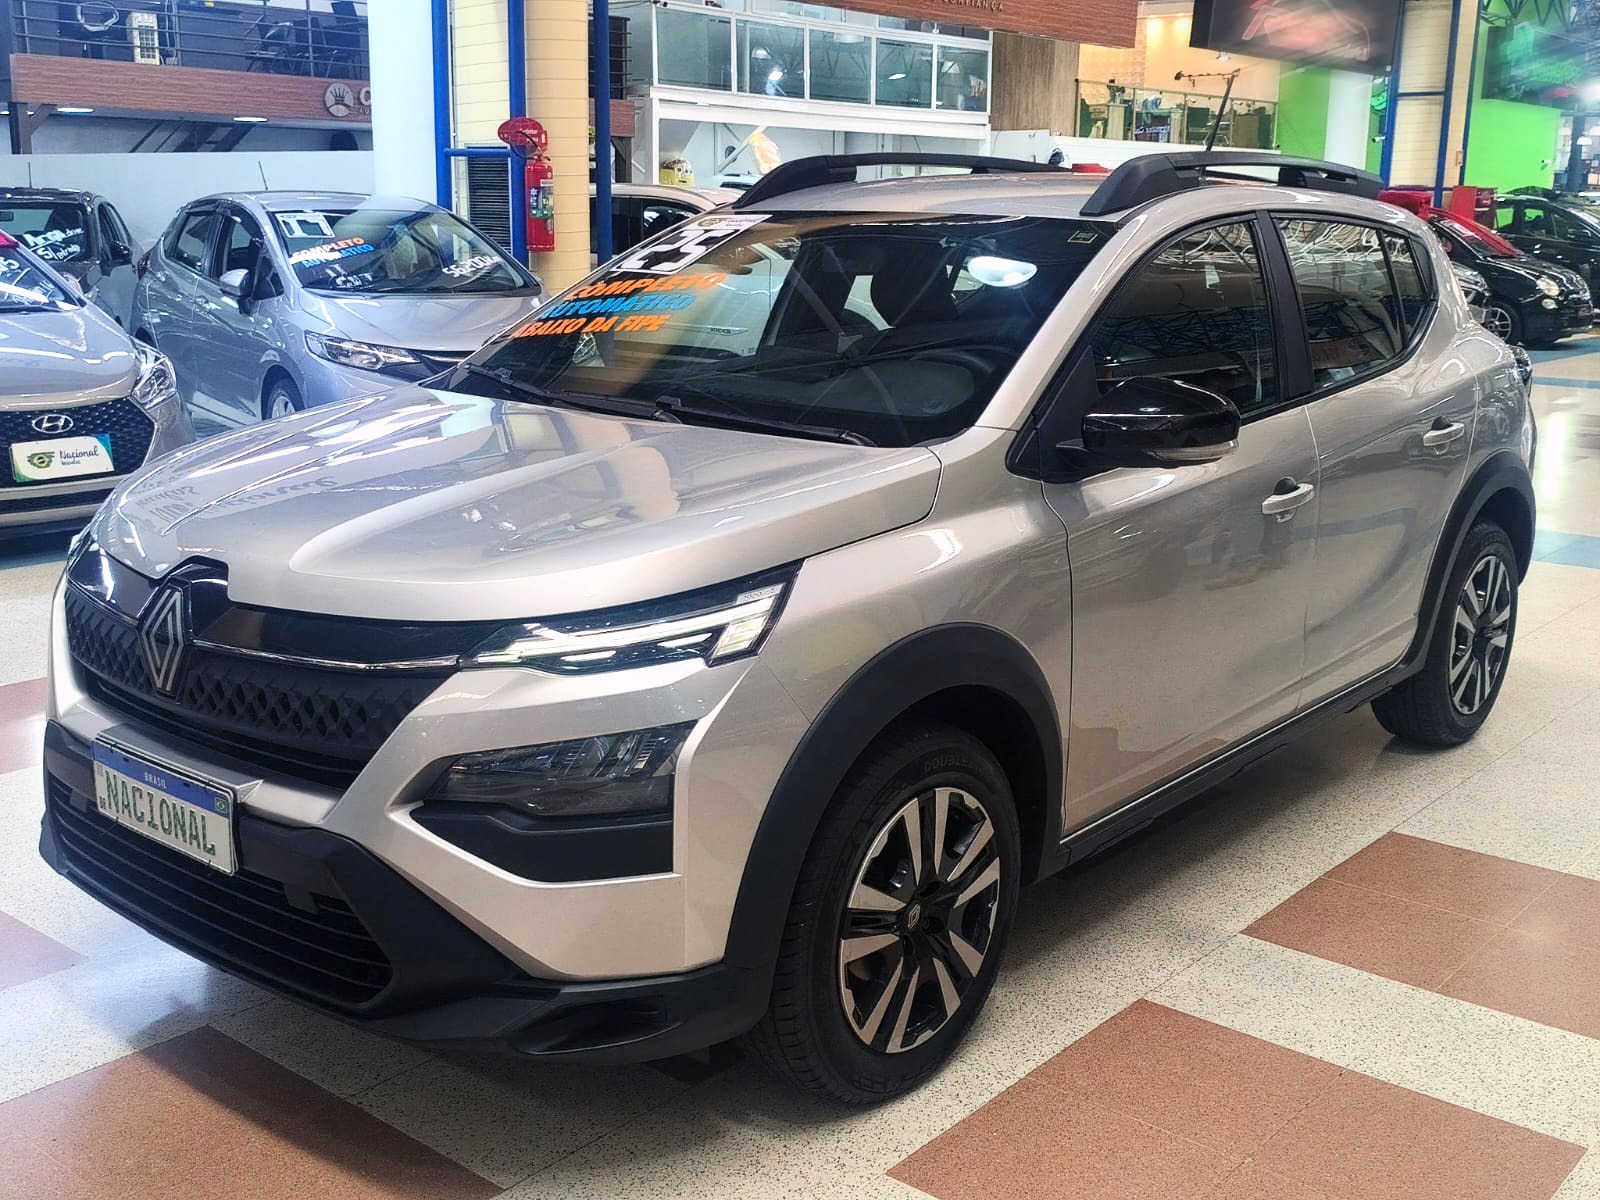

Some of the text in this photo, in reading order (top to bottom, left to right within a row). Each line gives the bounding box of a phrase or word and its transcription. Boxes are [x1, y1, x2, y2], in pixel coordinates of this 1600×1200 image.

[615, 228, 737, 271] 25
[564, 272, 730, 301] COMPLETO
[508, 314, 671, 339] ABAIXO DA FIPE
[59, 445, 99, 460] Nacional
[144, 771, 168, 790] BRASIL
[105, 770, 217, 856] NACIONAL
